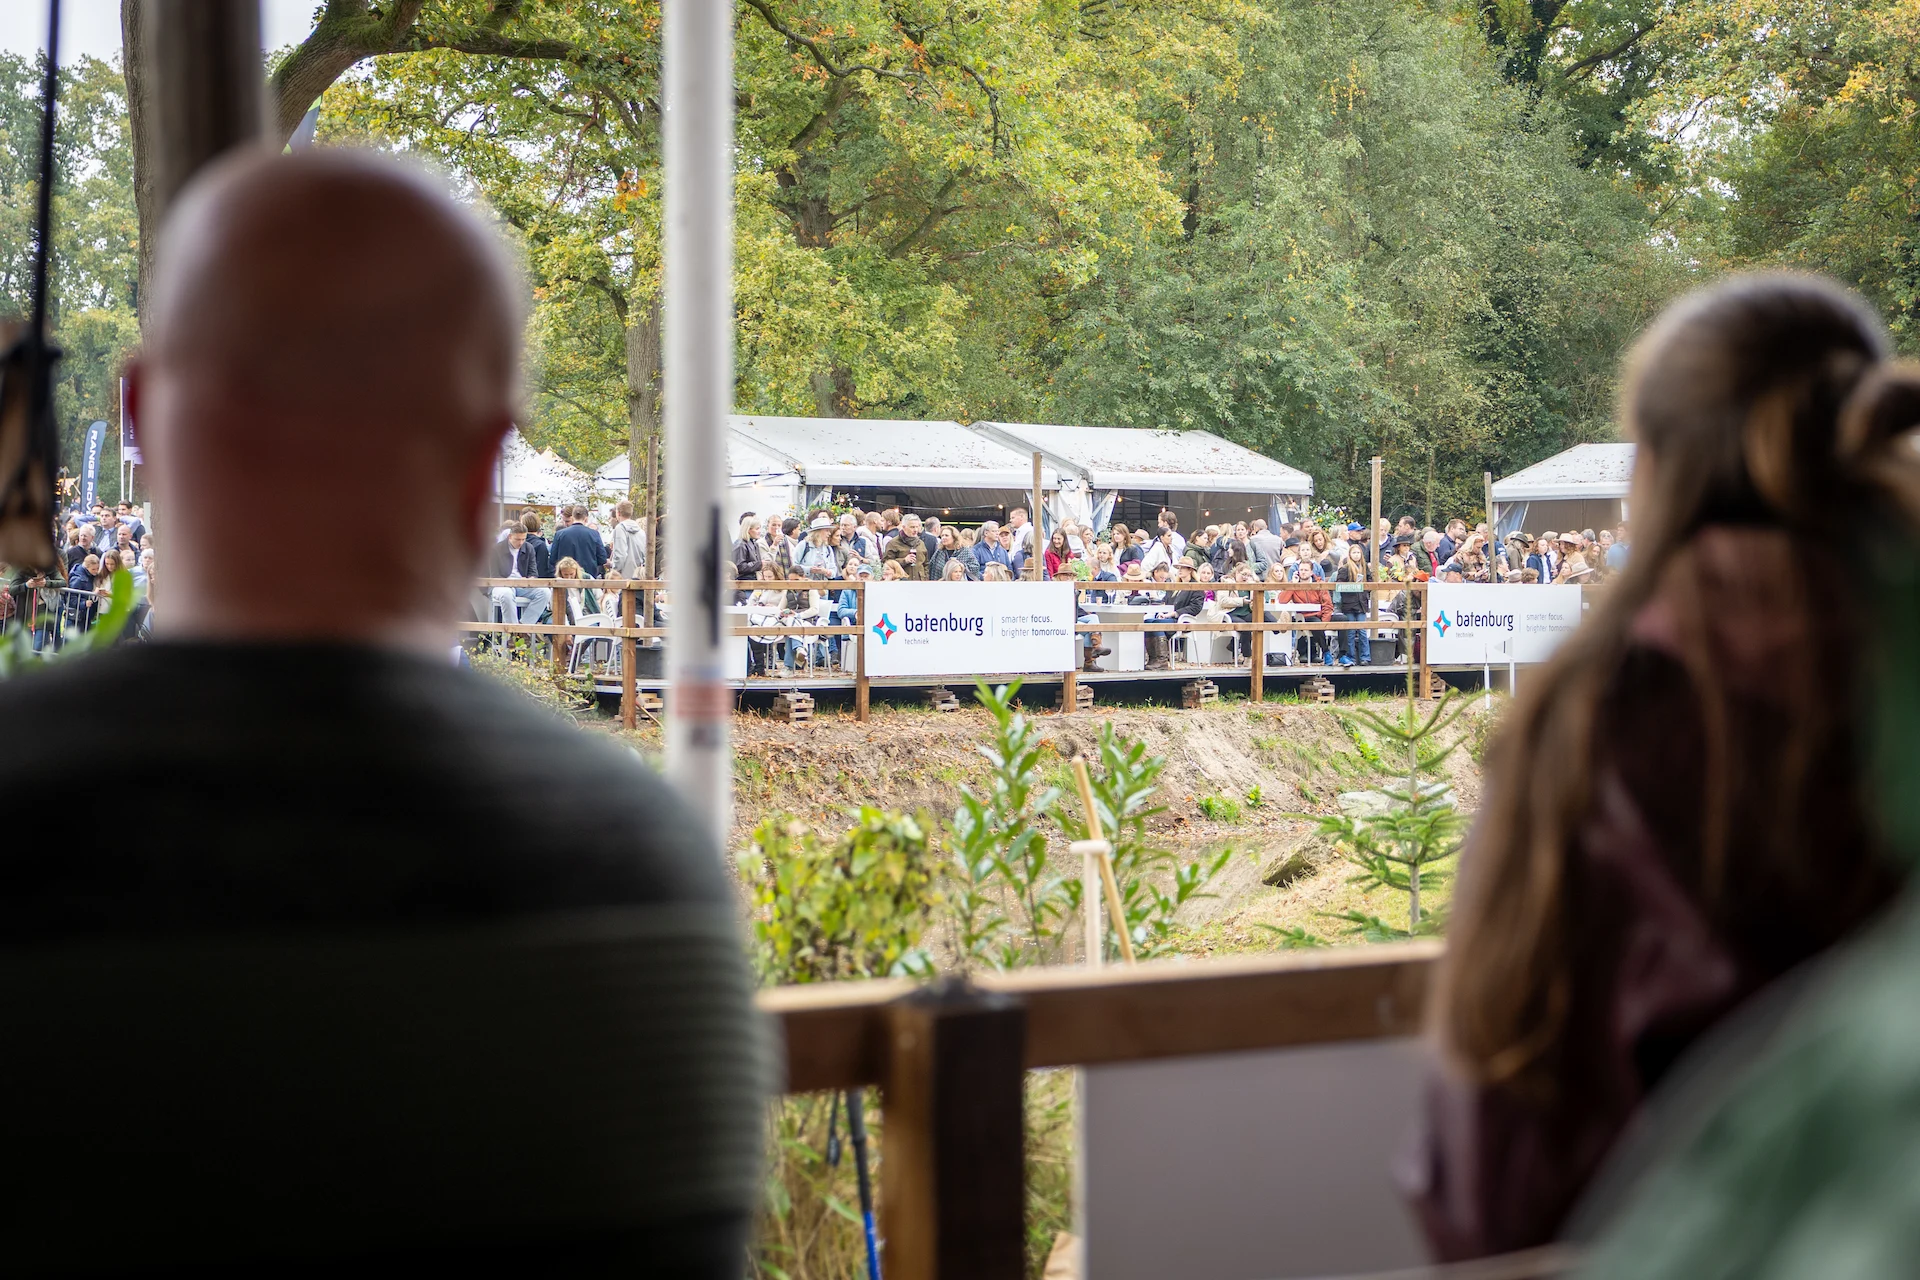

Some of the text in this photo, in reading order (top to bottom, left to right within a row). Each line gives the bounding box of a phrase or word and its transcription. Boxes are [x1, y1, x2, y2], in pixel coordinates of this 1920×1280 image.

[85, 430, 98, 514] RANGE ROV
[905, 612, 984, 636] batenburg
[1001, 613, 1053, 624] smarter focus.
[1456, 610, 1514, 631] batenburg
[1526, 613, 1547, 621] smarter
[1001, 627, 1069, 639] brighter tomorrow.
